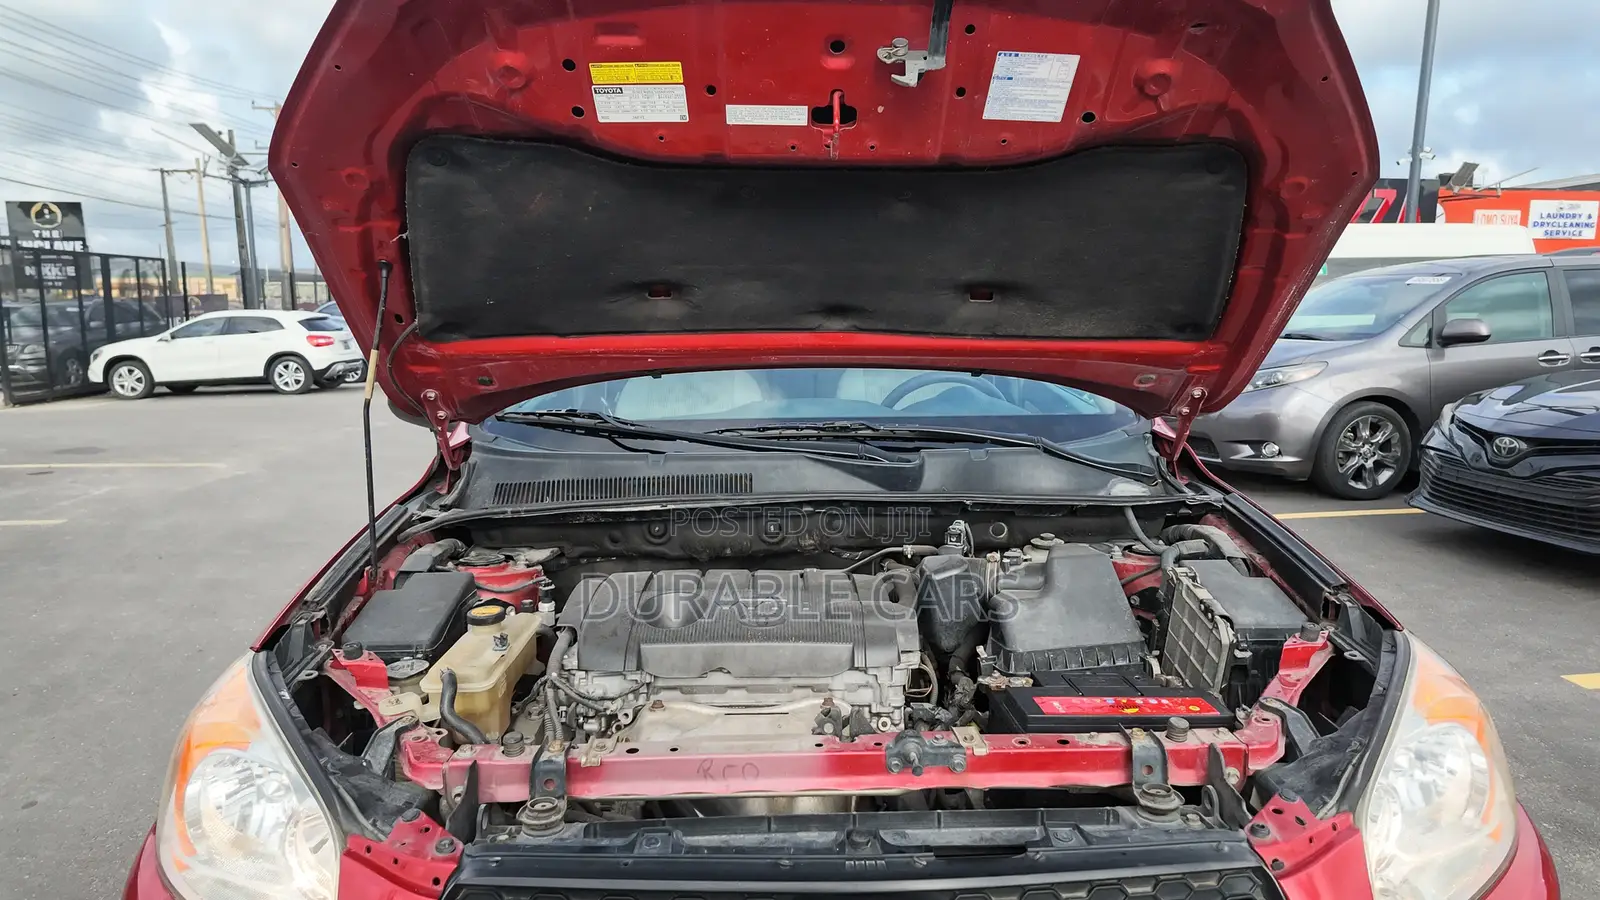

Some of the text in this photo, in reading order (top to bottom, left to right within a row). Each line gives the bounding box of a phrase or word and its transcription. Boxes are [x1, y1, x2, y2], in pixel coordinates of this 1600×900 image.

[1532, 220, 1595, 229] DRYCLEANING
[32, 229, 62, 238] THE
[1544, 229, 1583, 237] SERVICE
[24, 265, 76, 277] NKKIE
